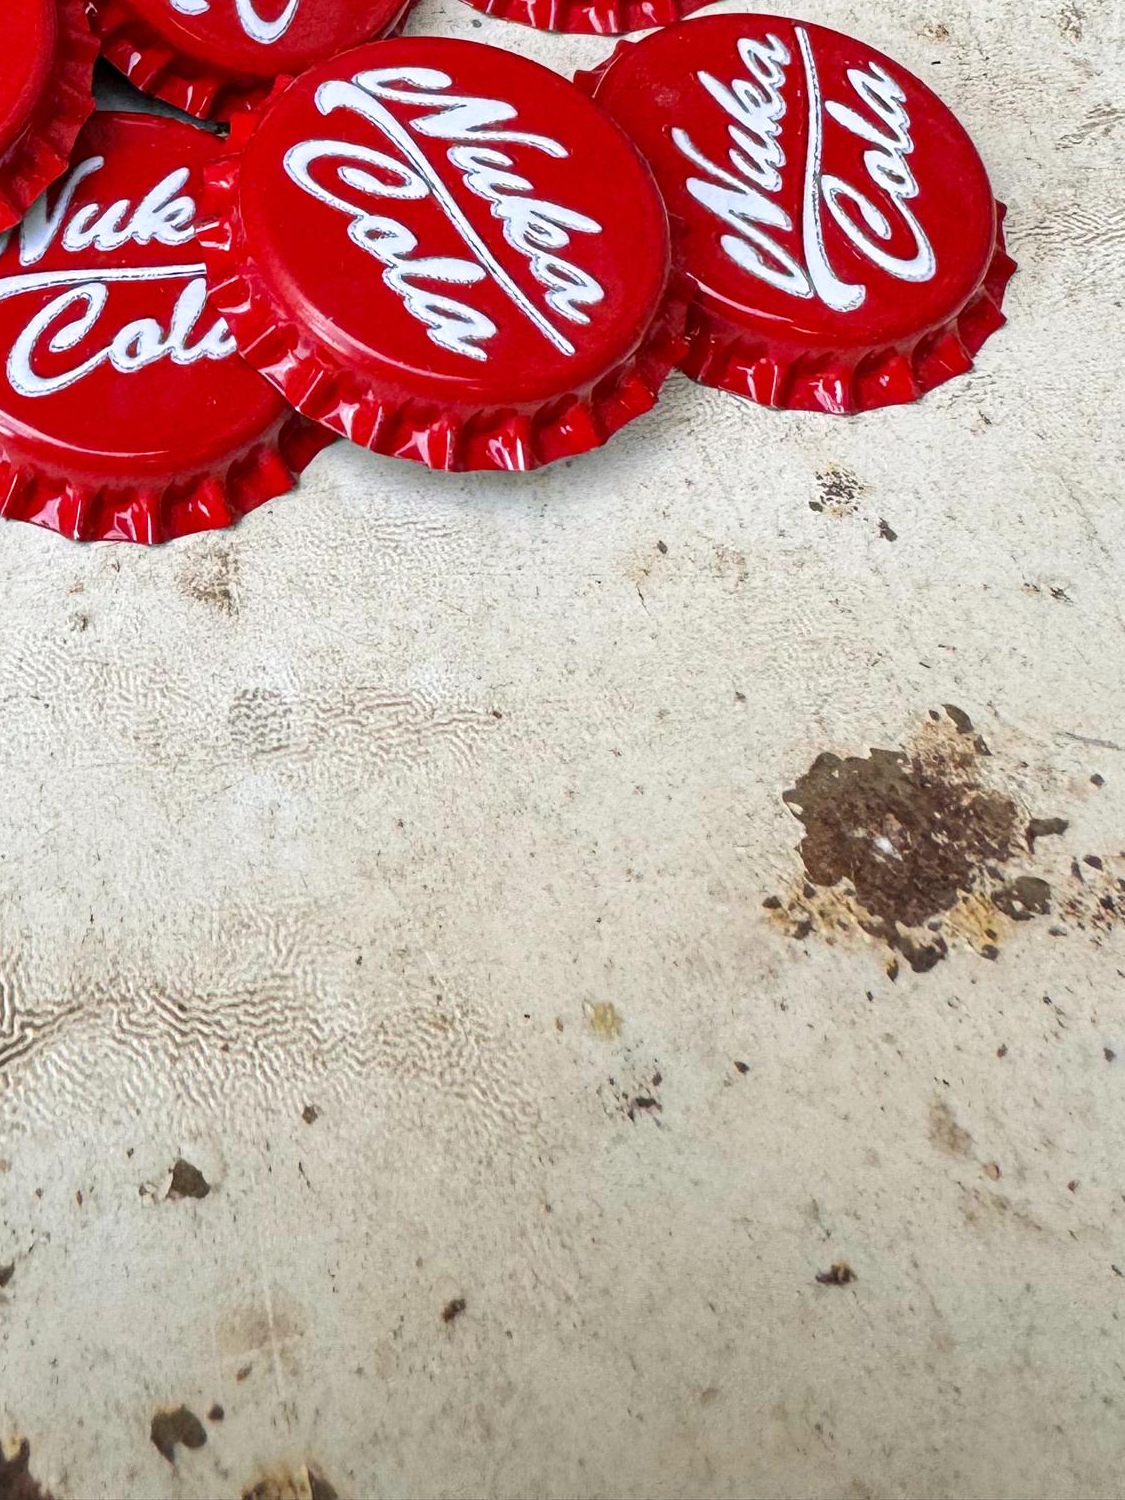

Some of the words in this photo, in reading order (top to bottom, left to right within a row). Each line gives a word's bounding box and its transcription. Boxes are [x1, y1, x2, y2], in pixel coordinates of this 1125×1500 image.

[282, 139, 499, 363] Cola
[350, 66, 606, 325] Nuka
[670, 32, 815, 300] Nuka
[820, 60, 937, 283] Cola
